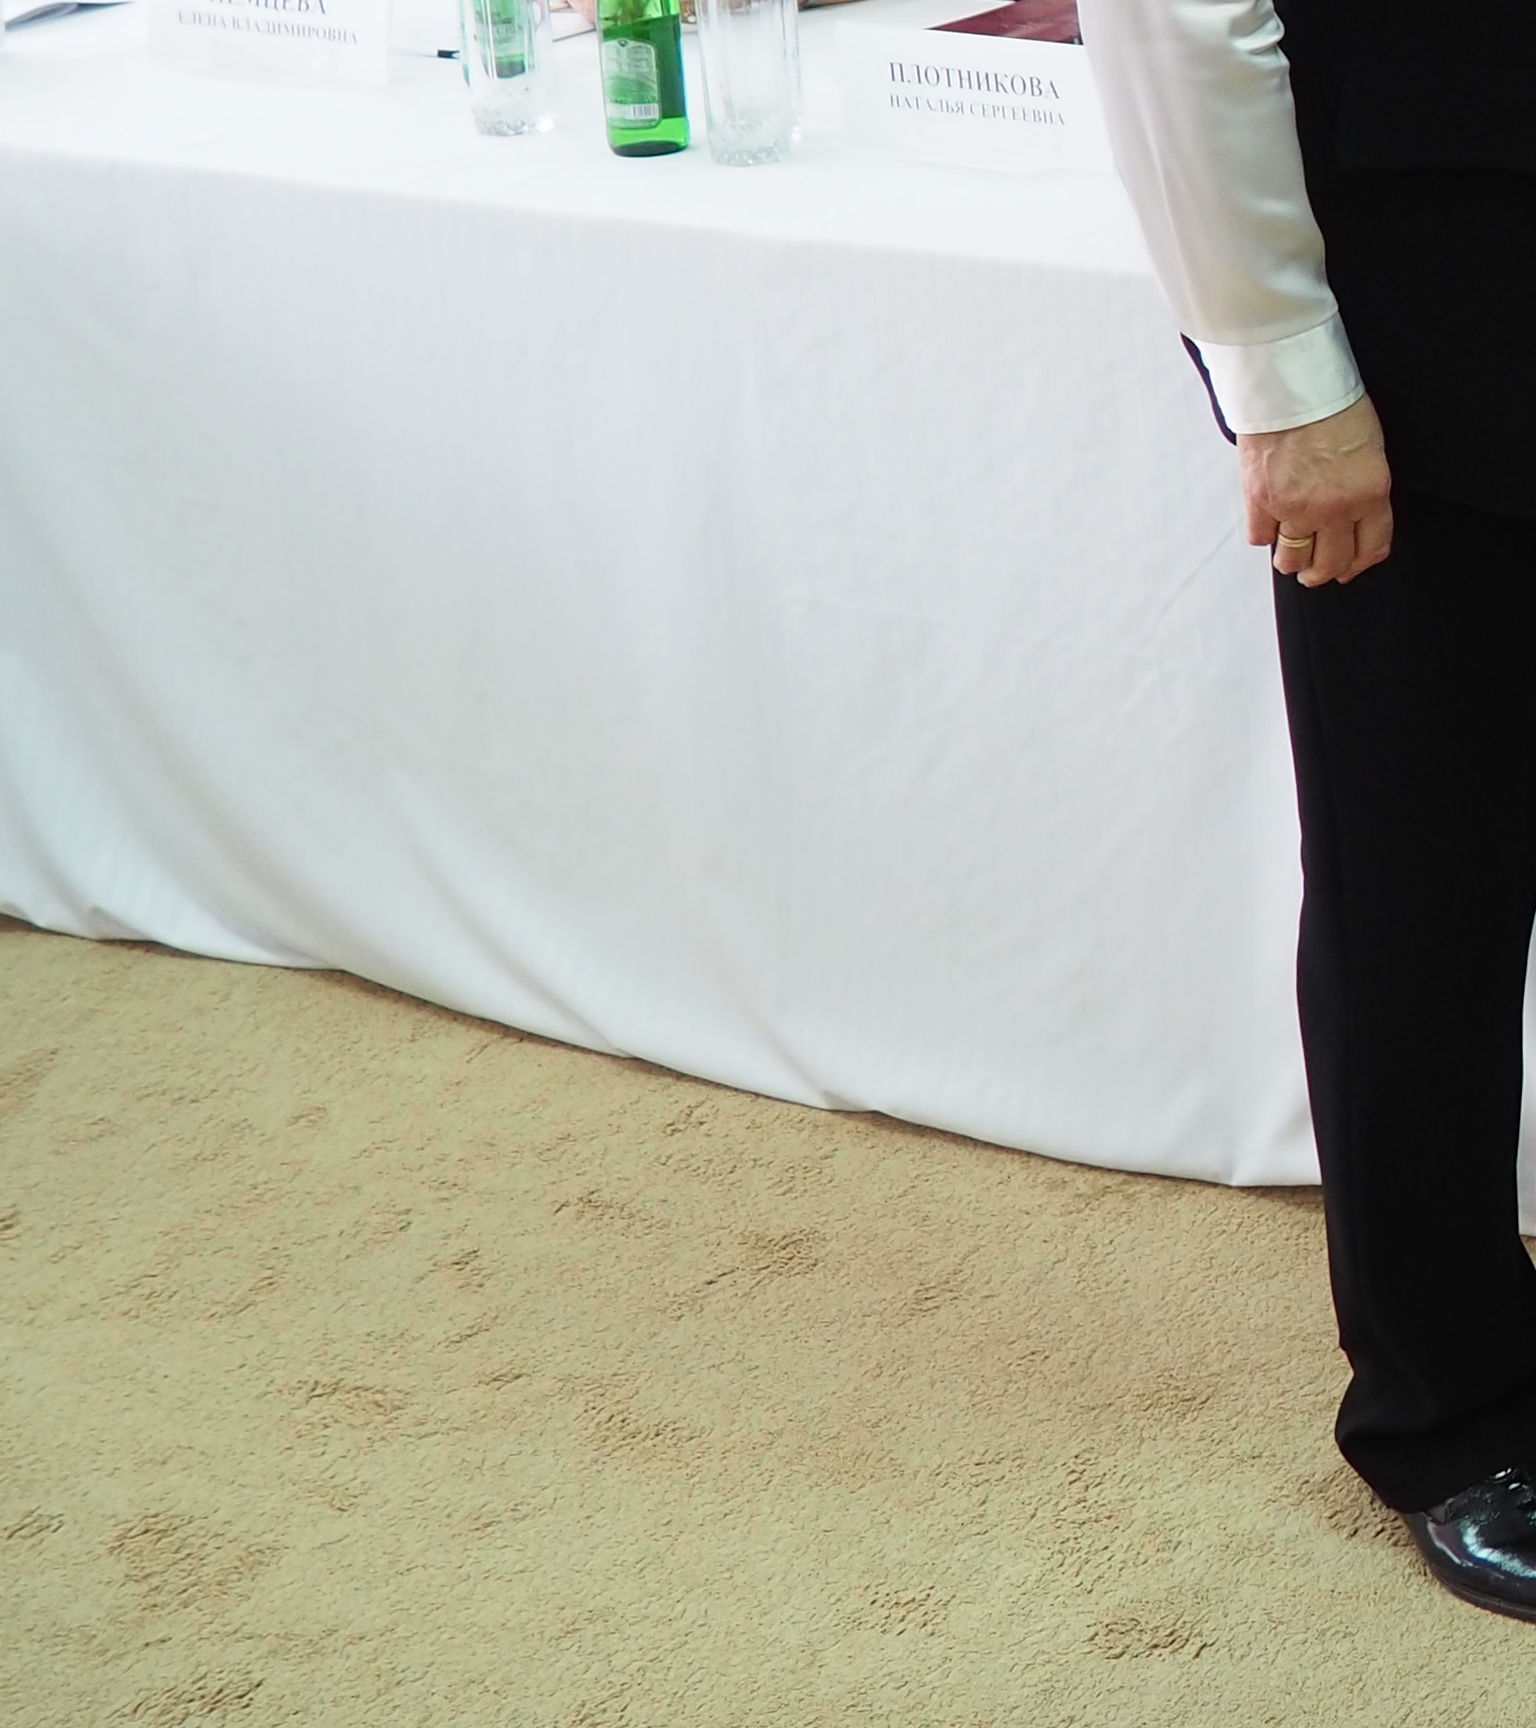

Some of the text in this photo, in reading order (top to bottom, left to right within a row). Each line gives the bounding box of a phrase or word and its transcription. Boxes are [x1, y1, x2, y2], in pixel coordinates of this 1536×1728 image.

[178, 10, 359, 44] ЕЛЕНА ВЛАДИМИРОВНА
[889, 61, 1061, 100] ПЛОТНИКОВА
[889, 93, 1066, 126] НАТАЛЬЯ СЕРГЕЕВНА
